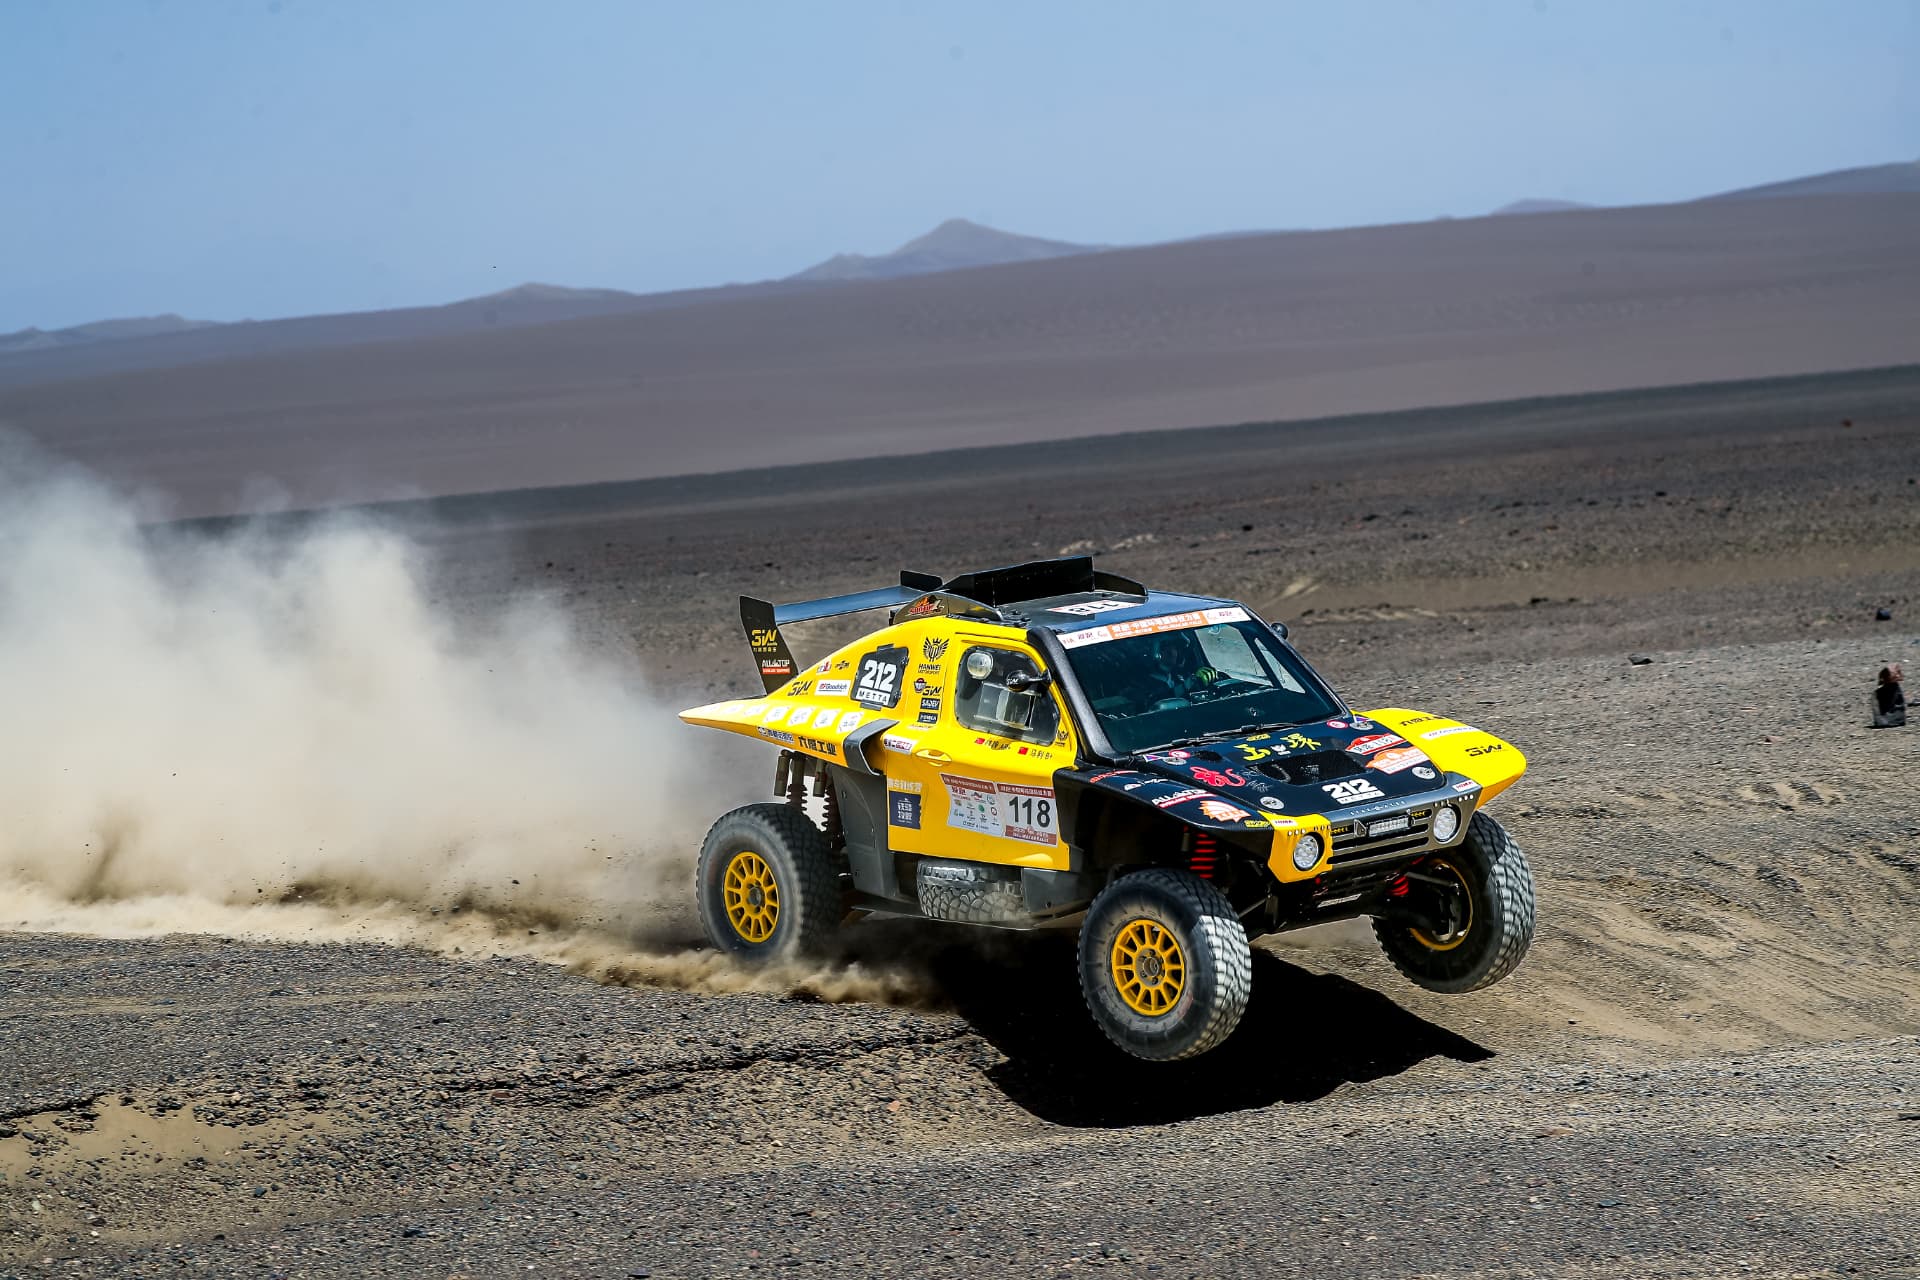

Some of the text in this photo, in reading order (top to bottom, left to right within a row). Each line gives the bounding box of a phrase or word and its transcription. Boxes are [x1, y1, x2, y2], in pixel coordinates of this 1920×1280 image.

[859, 659, 897, 693] 212
[918, 663, 941, 671] HANWEI
[858, 689, 888, 703] METTA
[1322, 778, 1378, 799] 212
[1009, 796, 1051, 828] 118
